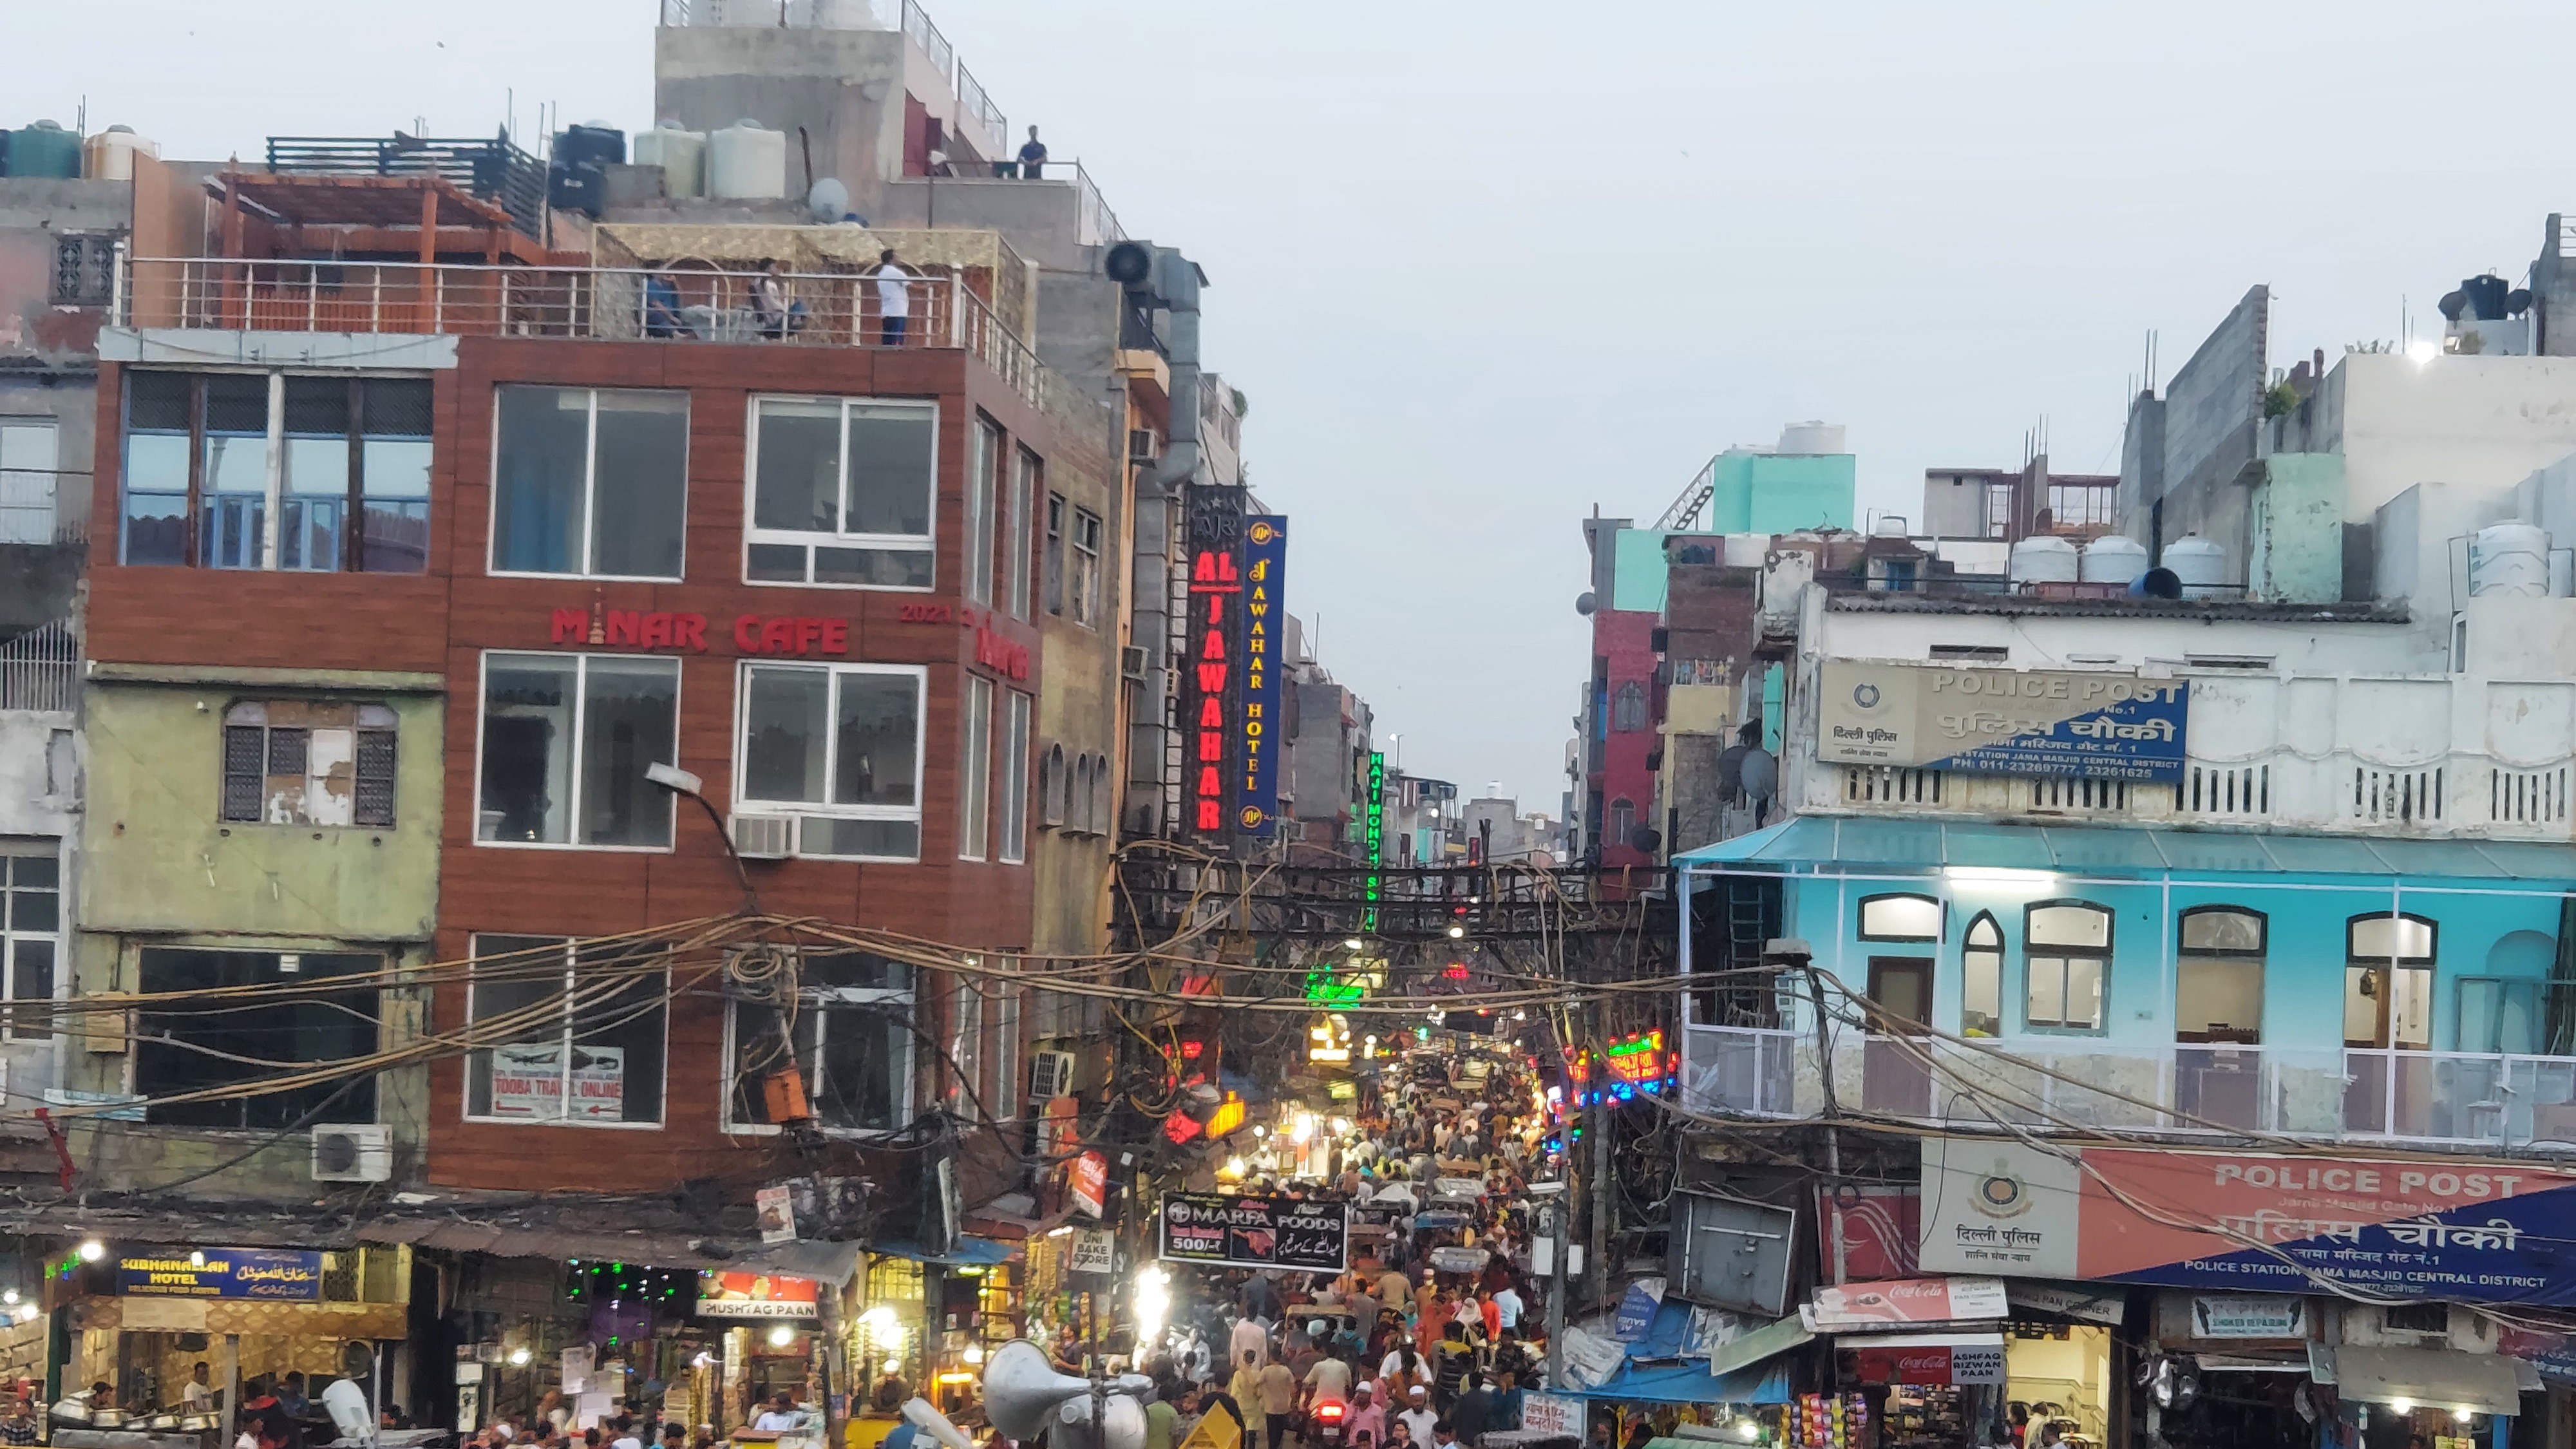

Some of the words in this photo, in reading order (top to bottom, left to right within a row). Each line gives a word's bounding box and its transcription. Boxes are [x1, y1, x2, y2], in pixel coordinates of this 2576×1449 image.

[1194, 551, 1237, 580] AL
[734, 614, 848, 654] CAFE
[1248, 558, 1272, 690] JAWAHAR
[1932, 674, 2069, 699] POLICE
[2081, 679, 2184, 704] POST
[1197, 595, 1227, 829] JAWAHAR
[1833, 725, 1864, 740] दिल्ली
[1866, 728, 1899, 744] पुलिस
[1936, 711, 2058, 738] पुलिस
[2069, 716, 2177, 743] चौकी
[1245, 703, 1264, 791] HOTEL
[2012, 752, 2040, 761] JAMA
[2083, 757, 2129, 766] CENTRAL
[2132, 760, 2179, 769] DISTRICT
[1370, 753, 1382, 801] HAJI
[495, 1078, 531, 1095] TOOBA
[581, 1081, 622, 1099] ONLINE
[2215, 1164, 2381, 1193] POLICE
[2400, 1172, 2523, 1198] POST
[1193, 1207, 1273, 1227] MARFA
[1276, 1215, 1341, 1231] FOODS
[1956, 1224, 1997, 1242] दिल्ली
[2000, 1226, 2042, 1247] पुलिस
[2383, 1214, 2524, 1252] चौकी
[1073, 1253, 1110, 1267] STORE
[1077, 1244, 1108, 1255] BAKE
[150, 1273, 199, 1285] HOTEL
[2184, 1260, 2238, 1273] POLICE
[2240, 1264, 2302, 1276] STATION
[2349, 1269, 2403, 1281] MASJID
[2407, 1271, 2476, 1285] CENTRAL
[2479, 1274, 2546, 1288] DISTRICT
[777, 1305, 815, 1316] PAAN
[1953, 1360, 2001, 1369] RIZWAN
[1961, 1368, 1994, 1377] PAAN
